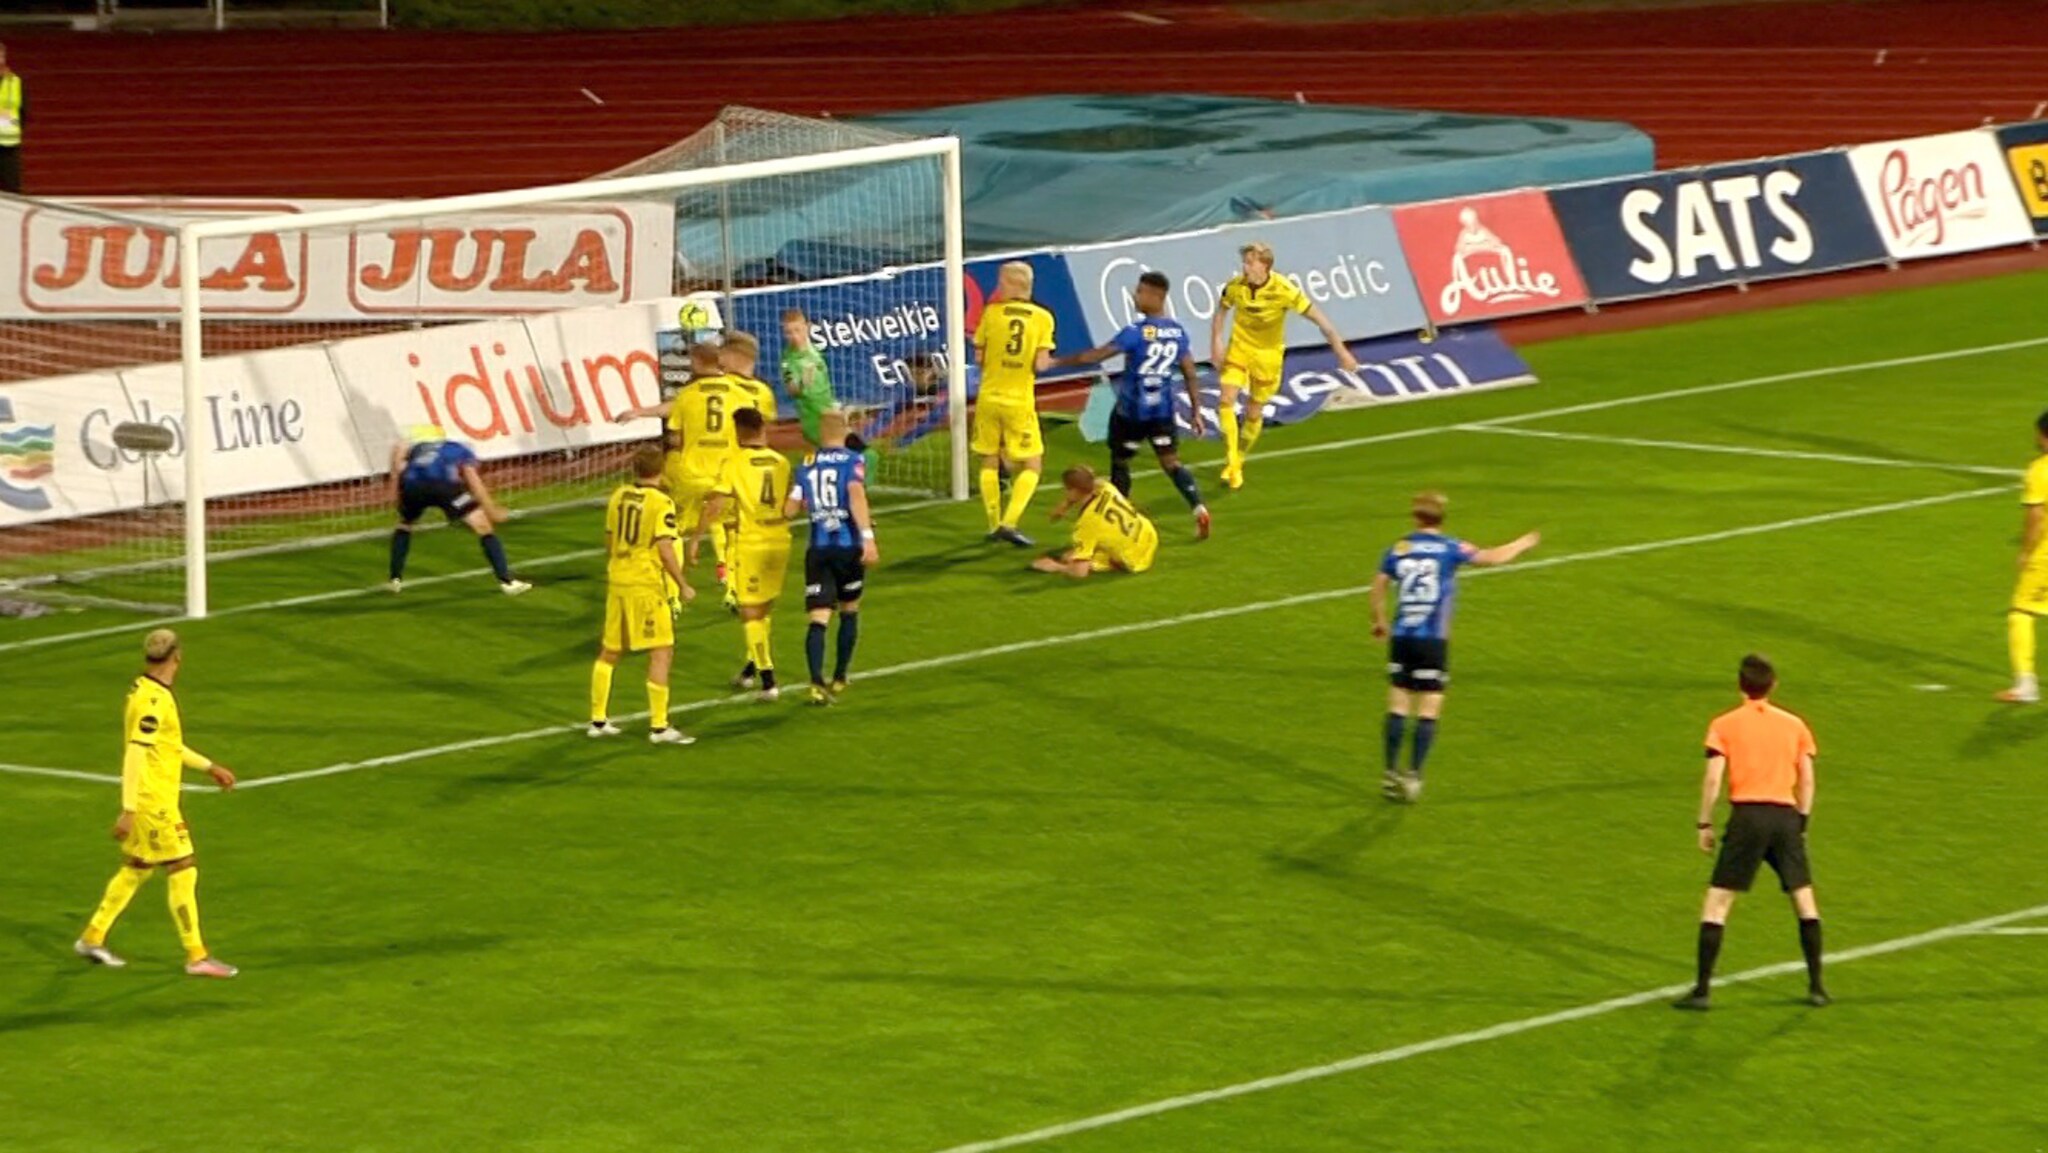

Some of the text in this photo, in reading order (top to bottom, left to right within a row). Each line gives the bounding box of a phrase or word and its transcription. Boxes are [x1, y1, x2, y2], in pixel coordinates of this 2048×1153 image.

[1879, 148, 1986, 246] Pågen
[1619, 170, 1814, 284] SATS
[361, 228, 620, 294] JULA
[1183, 254, 1391, 320] Oedic
[1440, 243, 1561, 315] Aulie
[1005, 318, 1025, 357] 3
[1138, 340, 1178, 374] 22
[408, 342, 660, 440] idium
[705, 395, 724, 433] 6
[203, 390, 304, 452] Line
[760, 470, 779, 509] 4
[807, 468, 838, 508] 16
[617, 499, 643, 548] 10
[1396, 557, 1440, 603] 23
